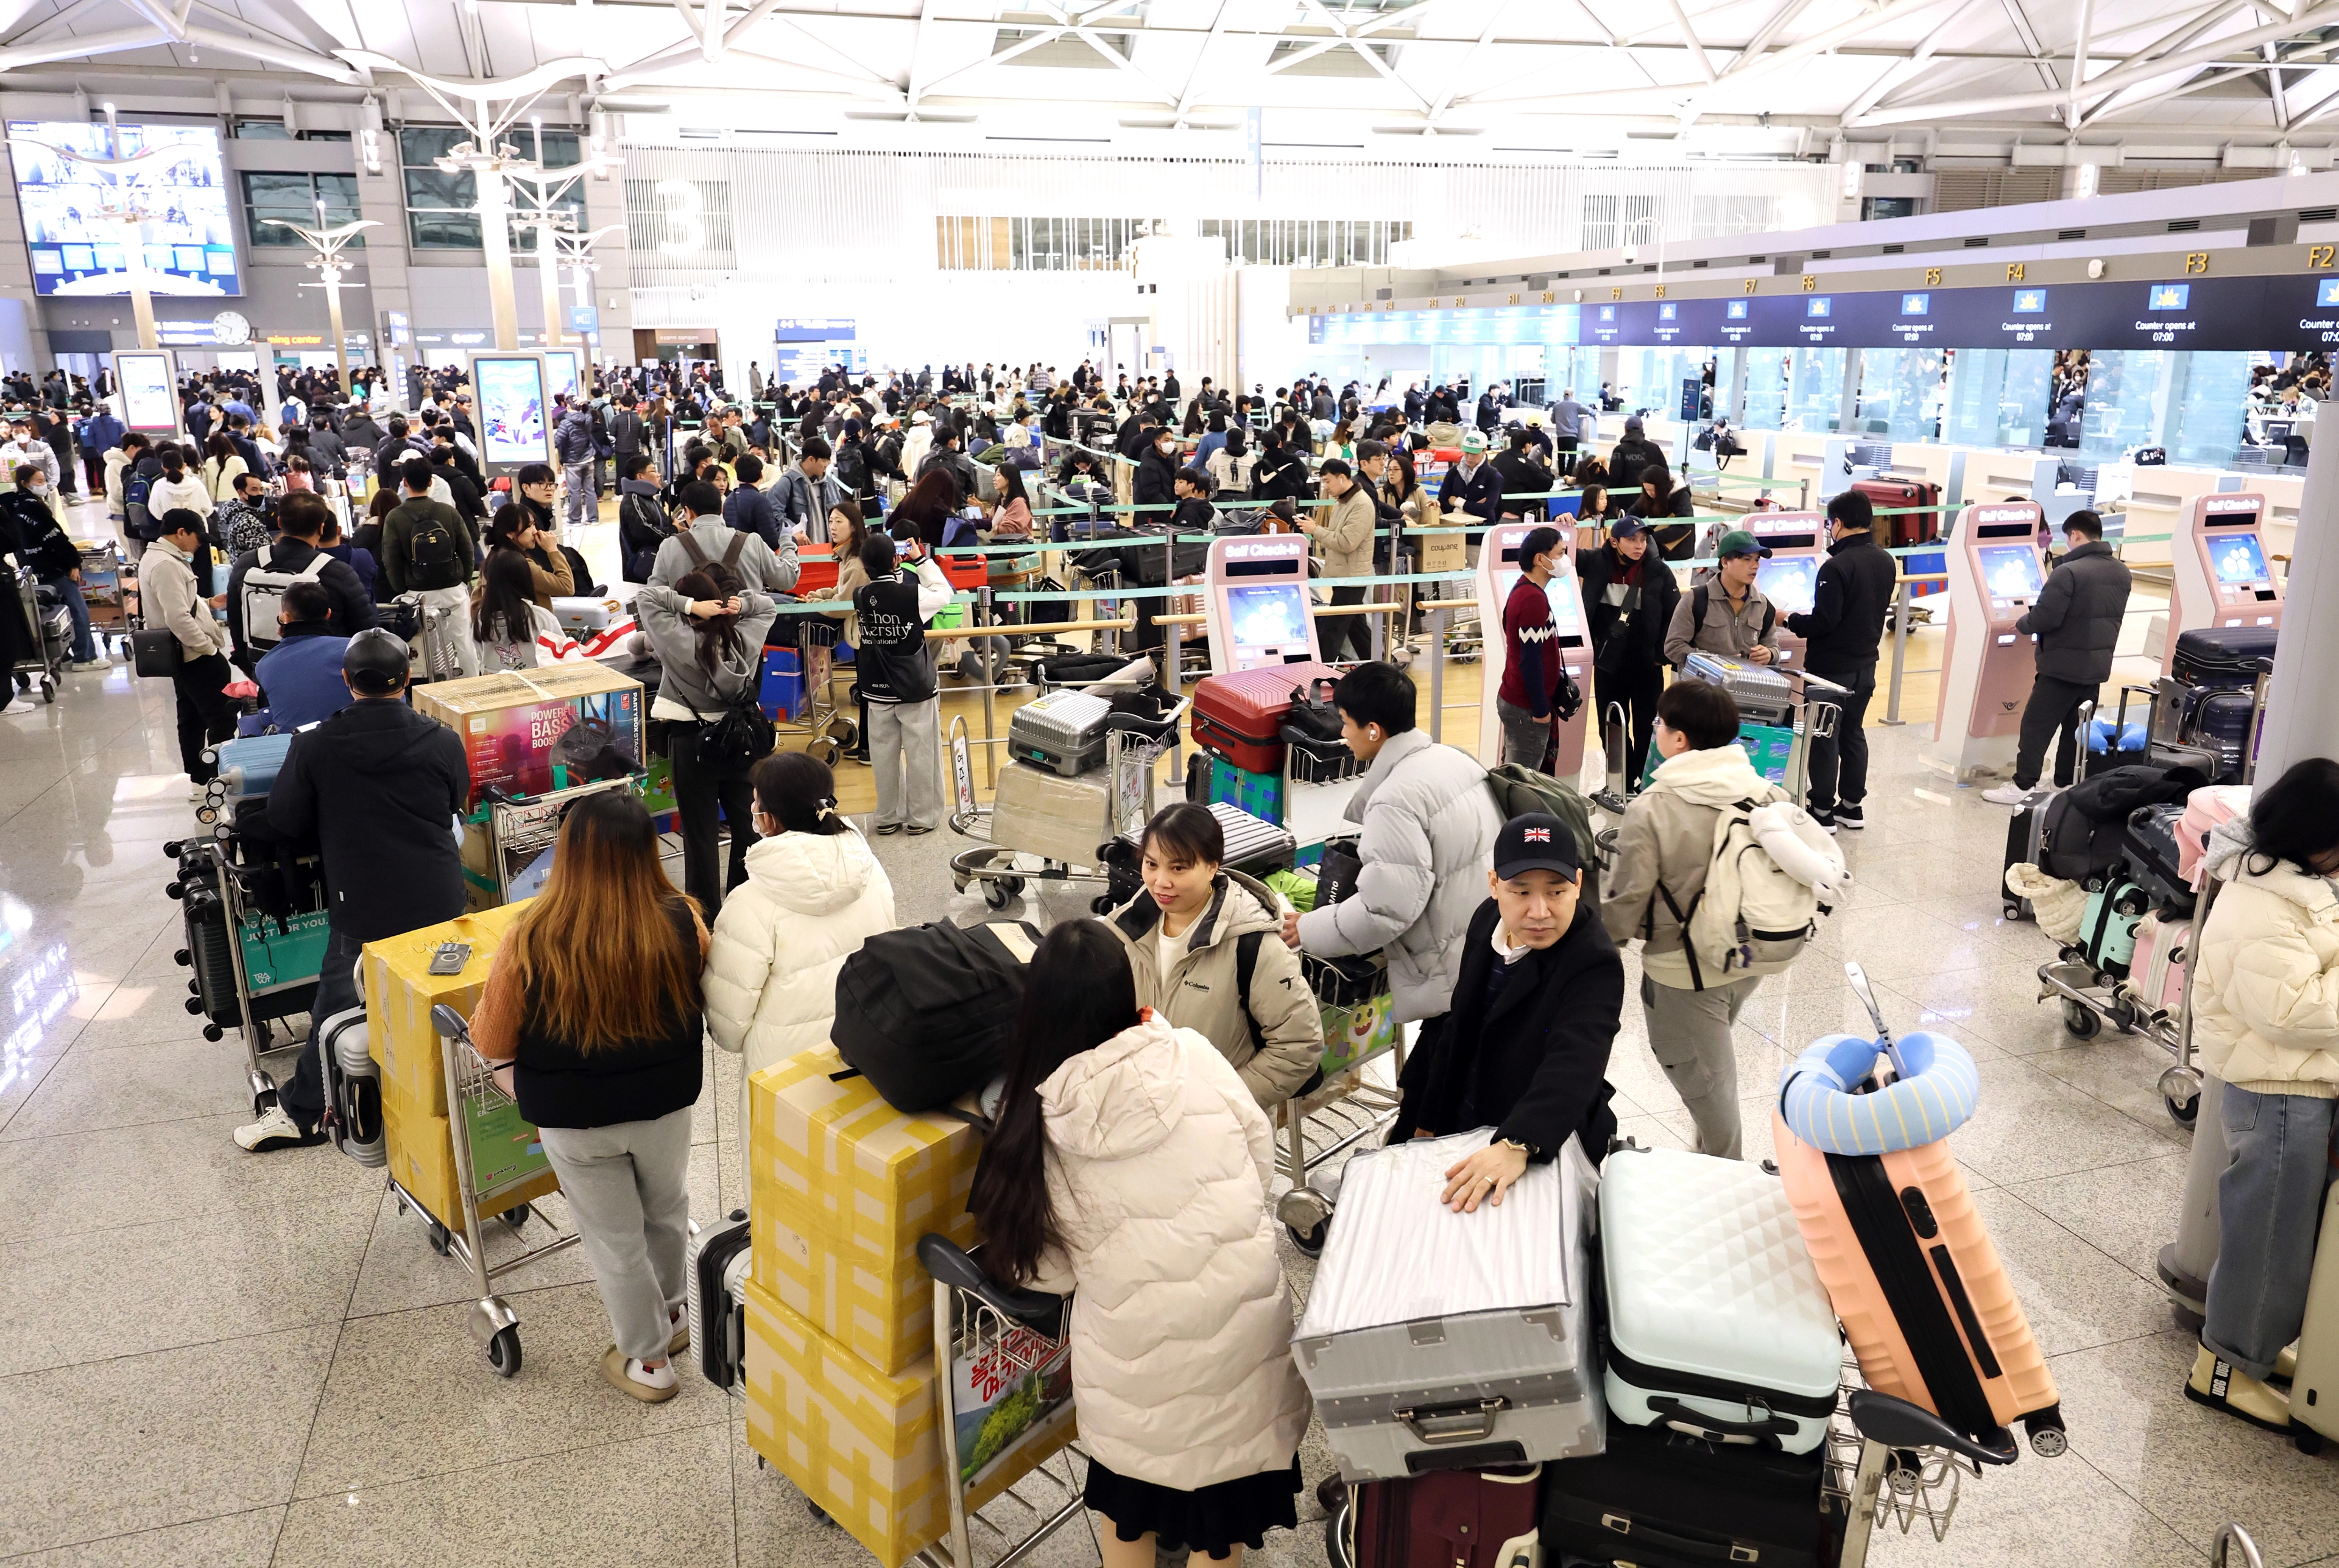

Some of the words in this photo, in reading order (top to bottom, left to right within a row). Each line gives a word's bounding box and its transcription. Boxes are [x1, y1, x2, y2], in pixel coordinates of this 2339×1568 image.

[2308, 245, 2335, 268] F2
[2186, 252, 2209, 274] F3
[1925, 268, 1942, 286] F5
[2006, 263, 2025, 282] F4
[1745, 279, 1757, 294] F7
[1802, 275, 1815, 291] F6
[1612, 287, 1621, 300] F9
[1654, 284, 1665, 298] F8
[1455, 296, 1466, 308] F12
[1508, 293, 1520, 304] F11
[1542, 292, 1553, 303] F10
[1892, 323, 1911, 332] Counter
[1911, 325, 1927, 334] opens
[2002, 322, 2025, 331] Counter
[2026, 324, 2044, 332] opens
[2135, 321, 2164, 330] Counter
[2164, 322, 2187, 332] opens
[2187, 321, 2196, 330] at
[2299, 319, 2335, 329] Counter
[291, 336, 322, 345] center
[1810, 333, 1823, 342] 07:00
[1904, 332, 1919, 342] 07:00
[2016, 332, 2034, 342] 07:00
[2153, 332, 2175, 342] 07:00
[2321, 332, 2339, 342] 07:0
[2206, 499, 2224, 512] Self
[2224, 498, 2260, 511] Check-in
[1978, 510, 1998, 522] Self
[1997, 508, 2036, 522] Check-in
[1754, 520, 1775, 533] Self
[1775, 518, 1818, 532] Check-in
[1501, 532, 1523, 544] Self
[1225, 544, 1249, 558] Self
[1249, 542, 1300, 557] Check-in
[1431, 543, 1458, 552] coupang
[531, 705, 579, 722] POWERFUL
[531, 716, 571, 739] BASS
[302, 918, 329, 929] YOU.
[1188, 981, 1210, 991] Columbia
[493, 1164, 517, 1178] pinkfong
[2215, 1361, 2230, 1377] UGG
[2212, 1379, 2227, 1397] UGG
